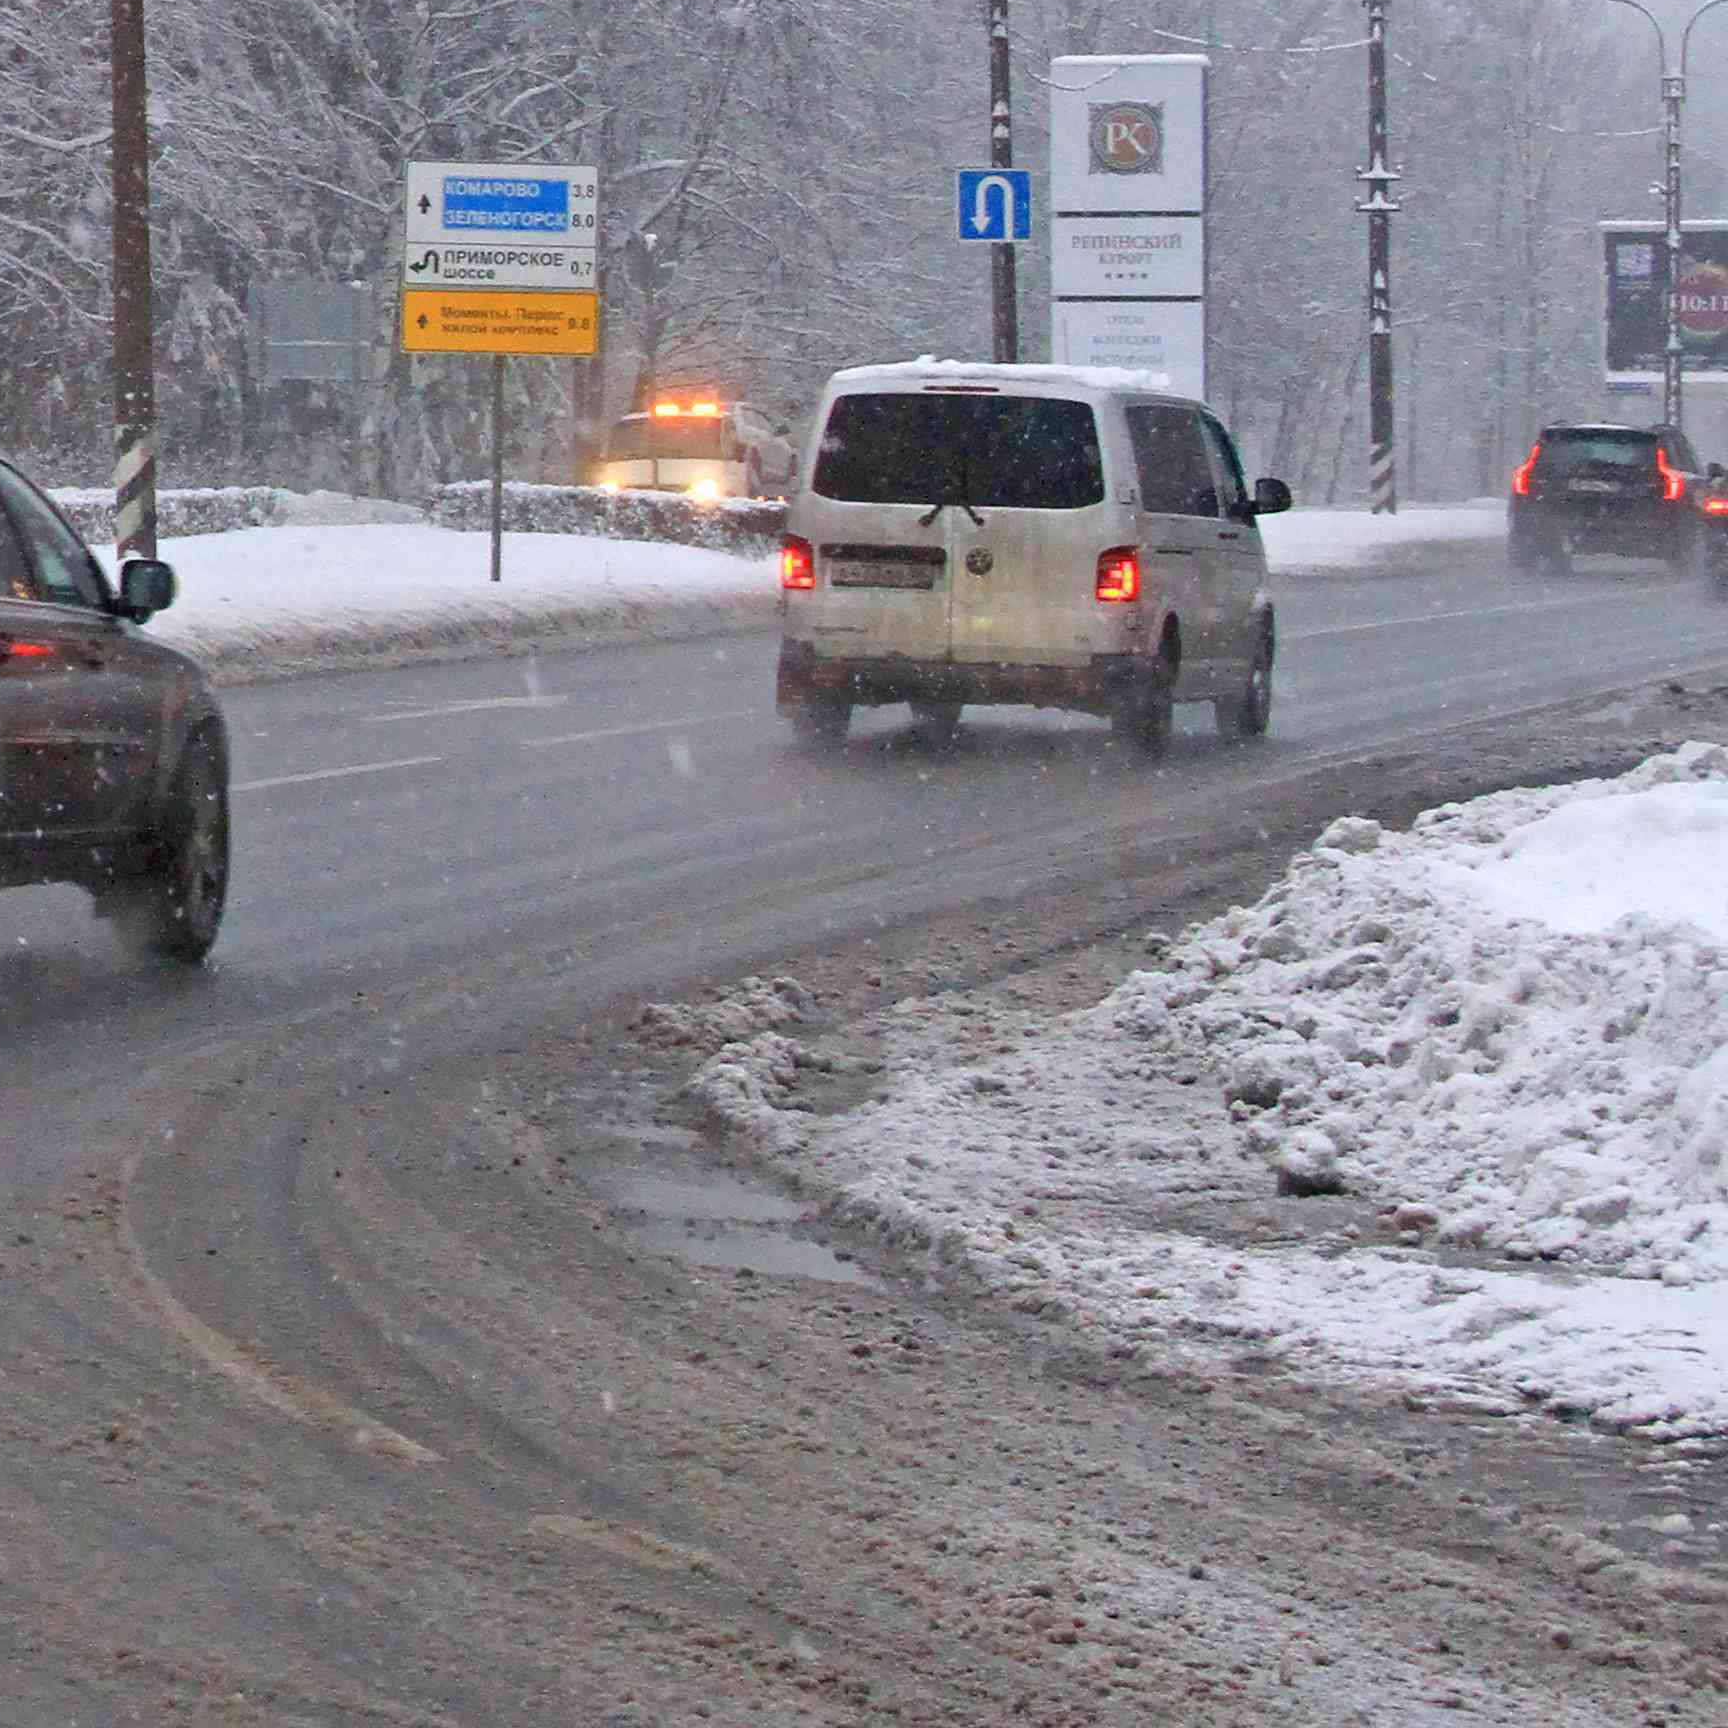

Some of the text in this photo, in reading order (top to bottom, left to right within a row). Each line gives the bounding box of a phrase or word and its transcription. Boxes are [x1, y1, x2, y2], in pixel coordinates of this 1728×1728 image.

[445, 181, 540, 198] КОМАРОВО
[445, 210, 566, 228] ЗЕЛЕНОГОРСК
[1071, 233, 1183, 250] РЕПИНСКИЙ
[444, 250, 564, 267] ПРИМОРСКОЕ
[444, 267, 495, 280] шоссе
